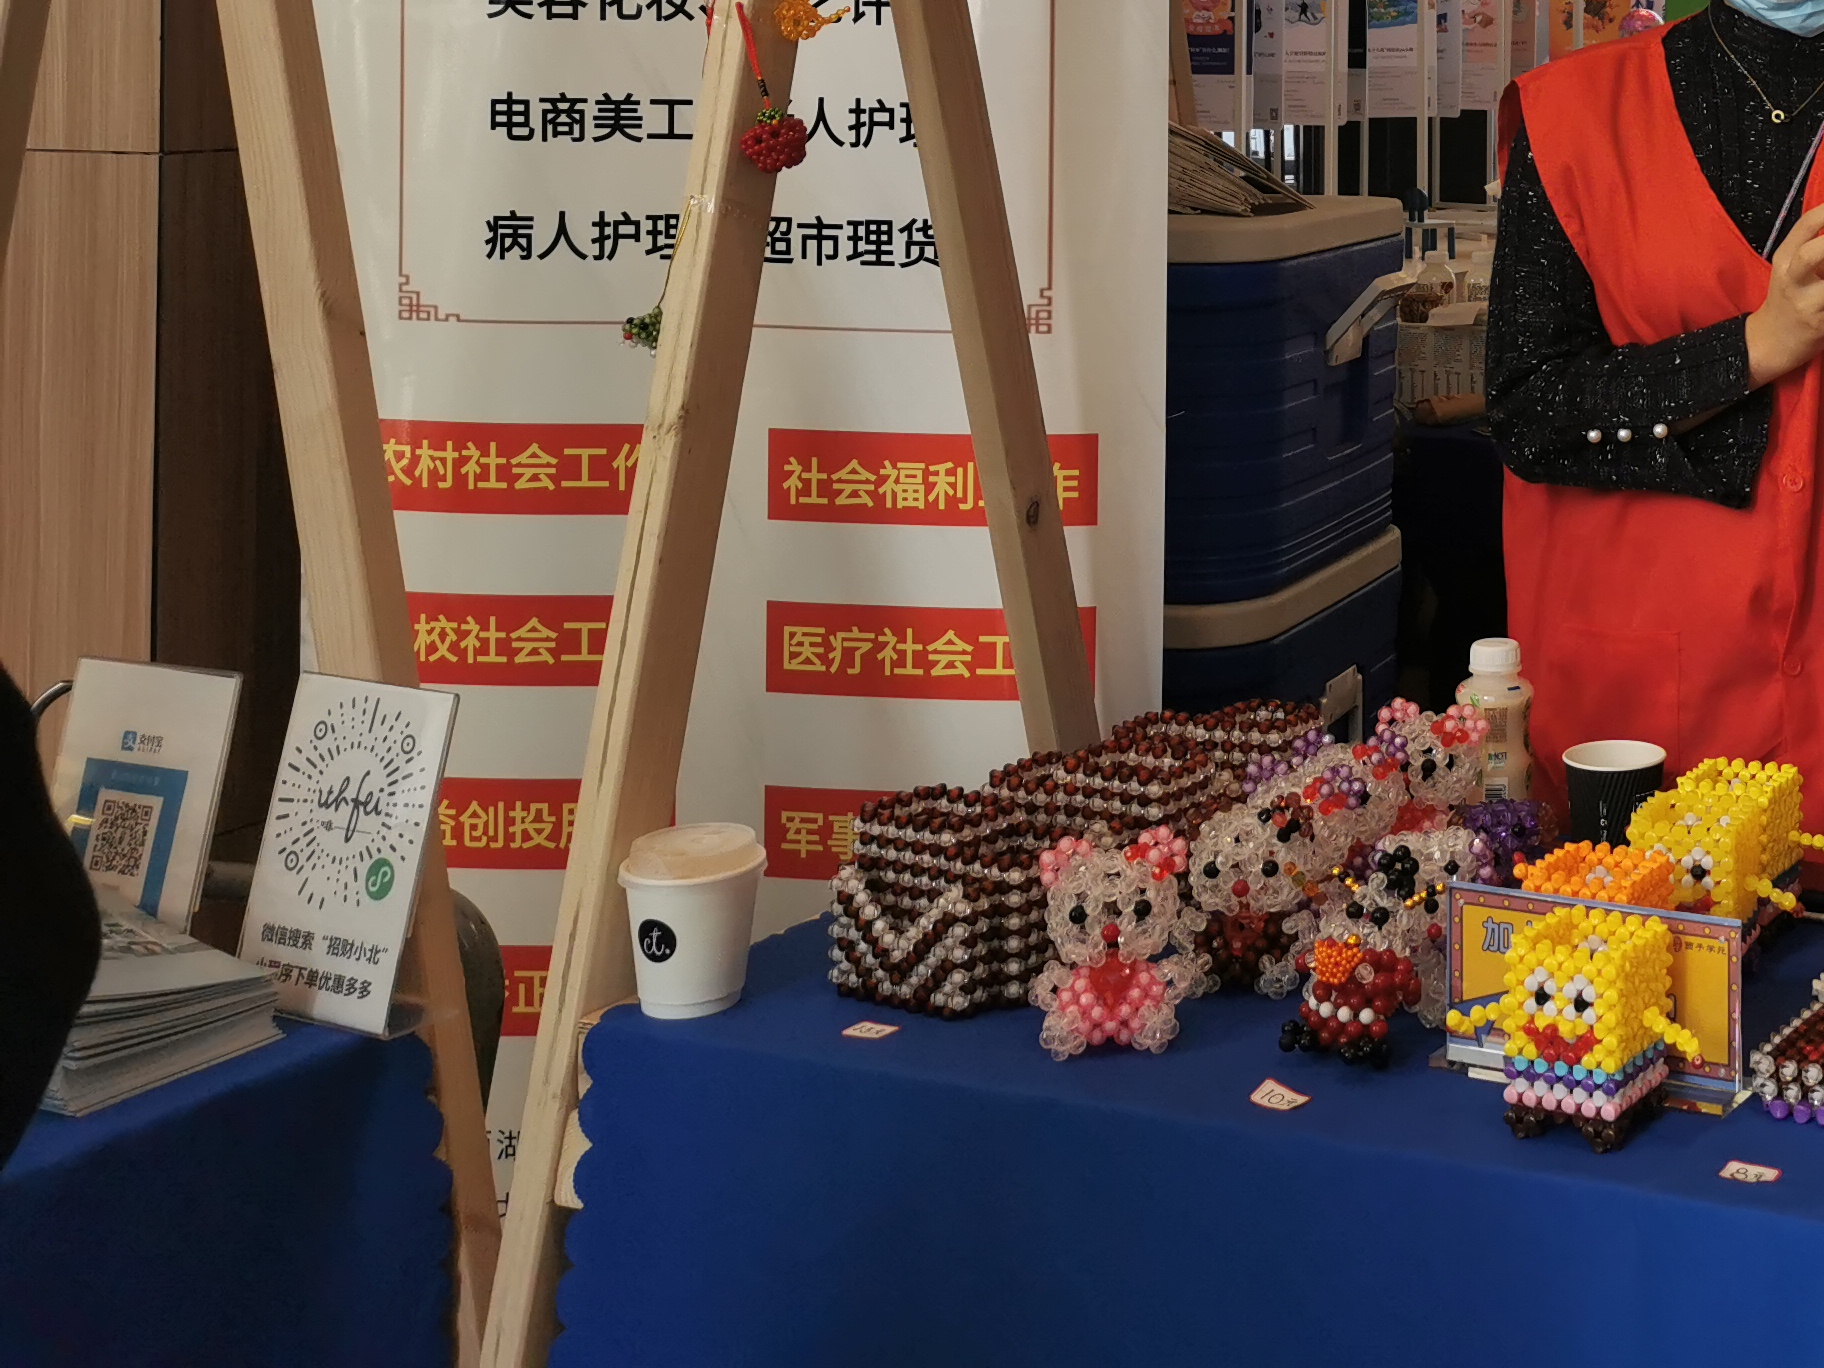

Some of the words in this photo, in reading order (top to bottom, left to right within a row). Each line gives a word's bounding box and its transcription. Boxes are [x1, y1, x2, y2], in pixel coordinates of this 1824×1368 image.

[782, 457, 1080, 510] 社会福利作
